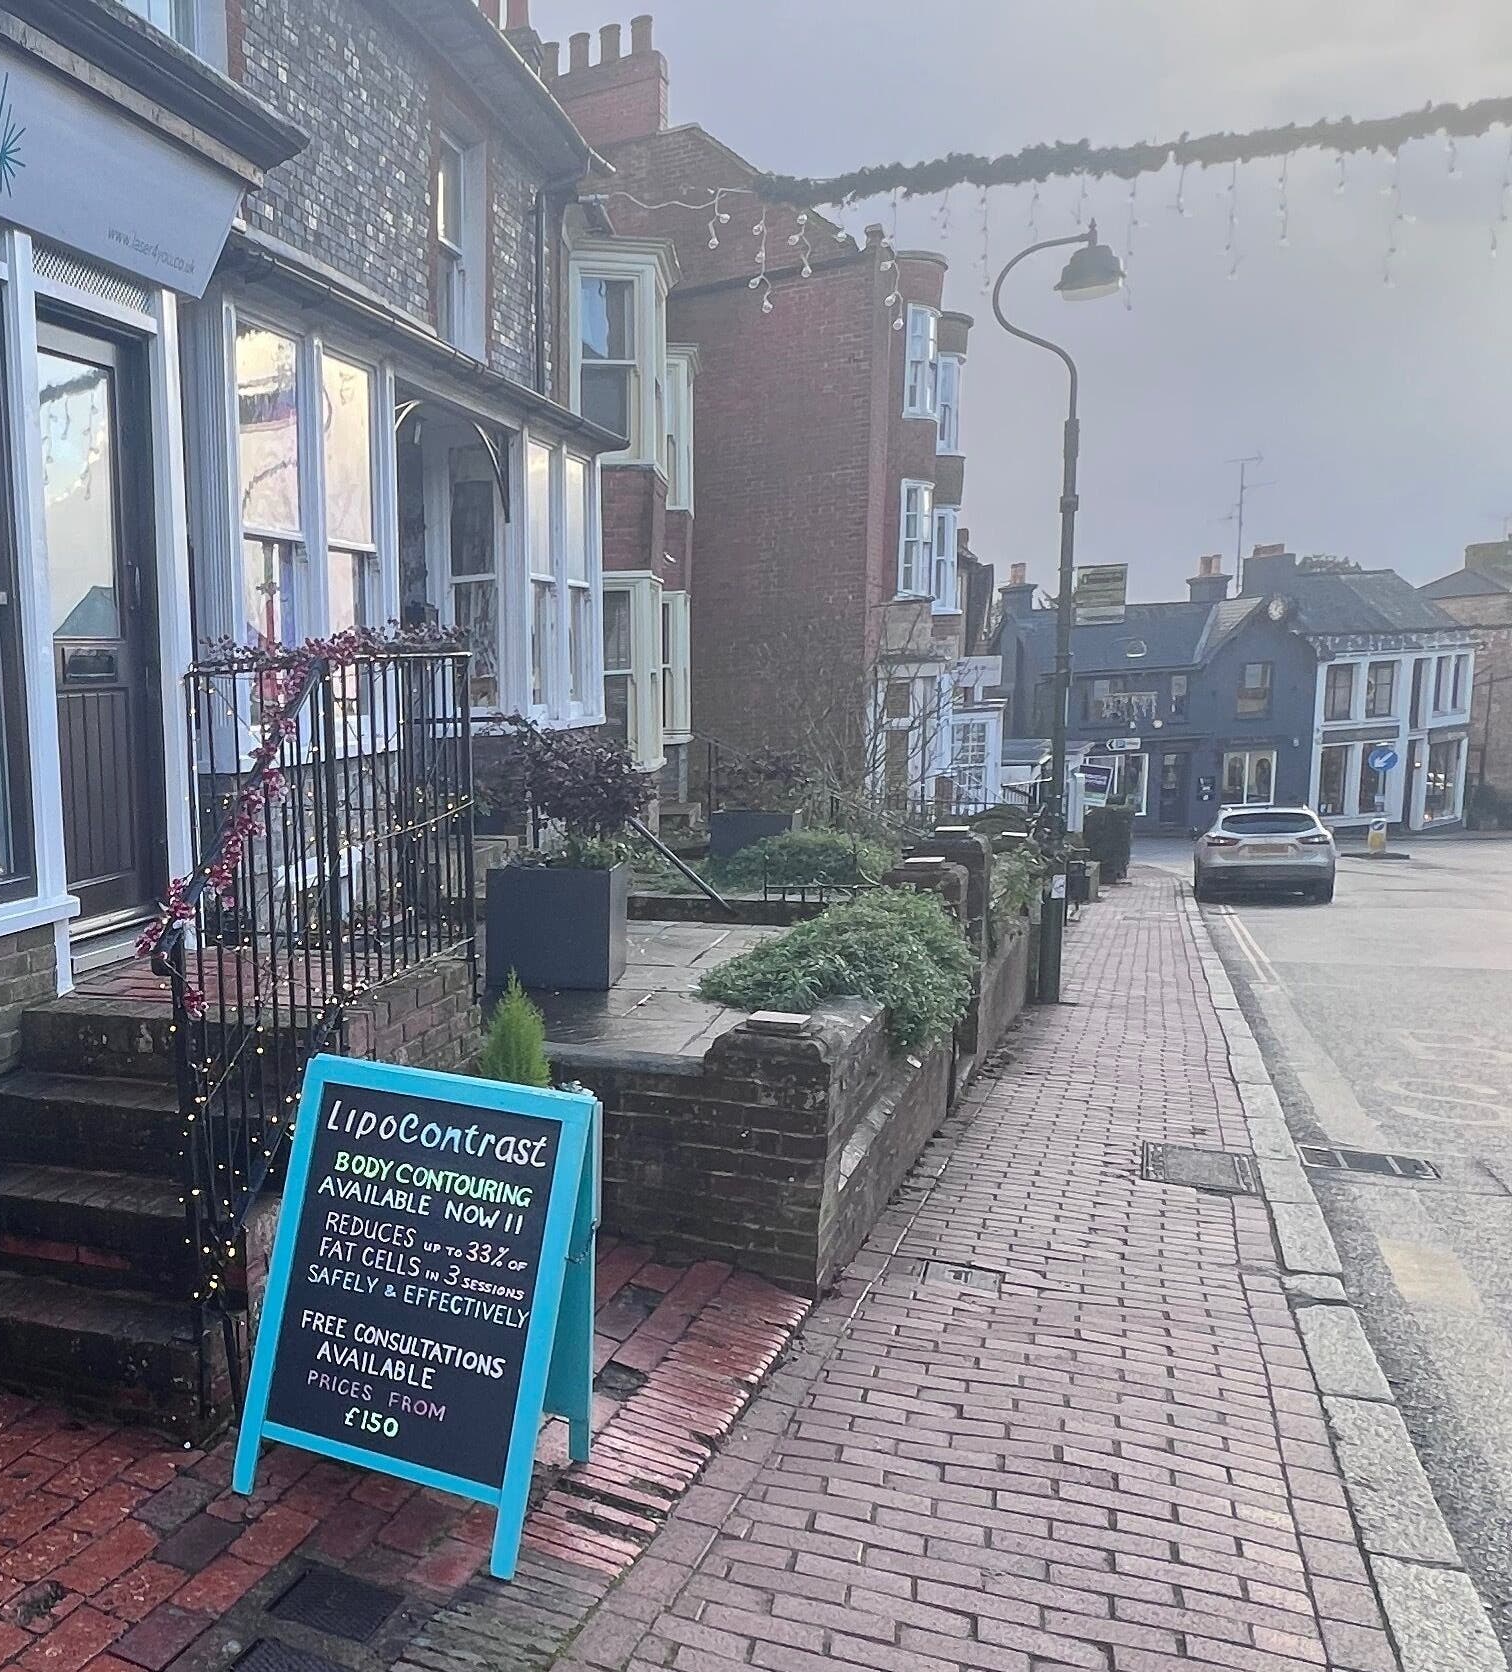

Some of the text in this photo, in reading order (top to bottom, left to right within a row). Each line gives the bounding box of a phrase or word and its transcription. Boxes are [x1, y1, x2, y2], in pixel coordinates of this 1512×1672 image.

[318, 1176, 432, 1216] AVAILABLE
[444, 1200, 501, 1230] NOW
[334, 1151, 533, 1208] BODY CONTOURING
[319, 1236, 525, 1301] FAT CELLS IN 3 SESSIONS
[325, 1211, 528, 1272] REDUCES UP TO 33% OF
[307, 1263, 531, 1330] SAFELY & EFFECTIVELY
[300, 1309, 507, 1380] FREE CONSULTATIONS
[316, 1341, 436, 1391] AVAILABLE
[307, 1369, 446, 1423] PRICES FROM
[344, 1406, 400, 1439] £150
